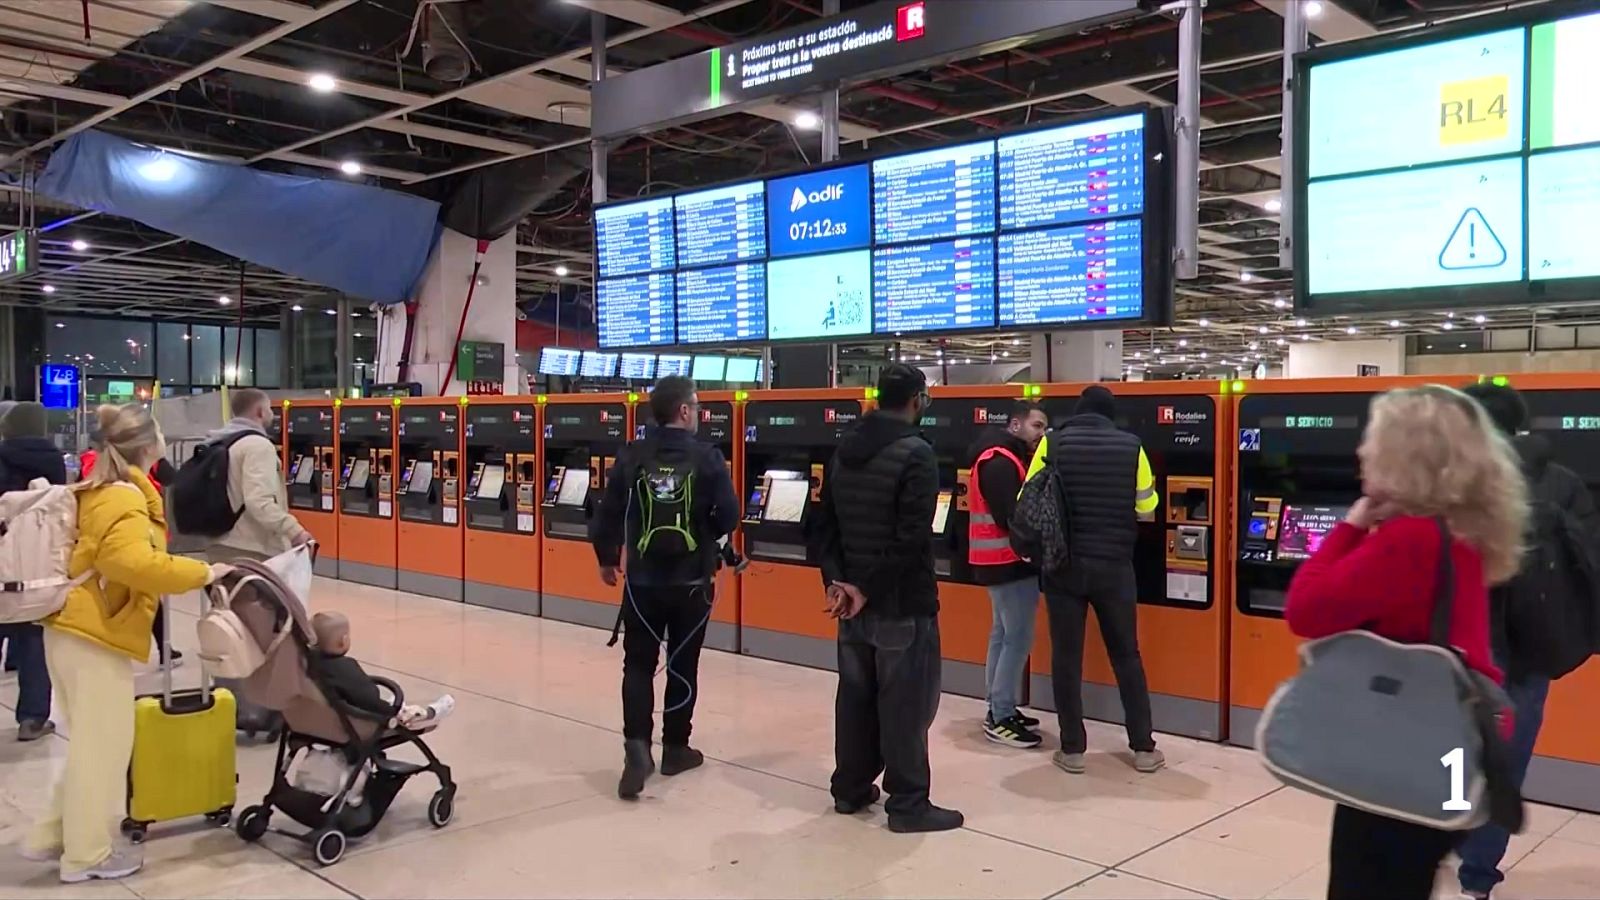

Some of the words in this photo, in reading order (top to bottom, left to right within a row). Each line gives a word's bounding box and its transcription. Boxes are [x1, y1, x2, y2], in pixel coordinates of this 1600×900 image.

[906, 6, 924, 31] R
[742, 43, 776, 62] Próximo
[778, 38, 796, 53] tren
[798, 36, 804, 47] a
[806, 32, 816, 46] su
[818, 20, 857, 42] estación
[742, 60, 770, 78] Proper
[772, 55, 790, 70] tren
[792, 53, 798, 64] a
[800, 49, 810, 62] la
[811, 41, 840, 59] vostra
[842, 24, 893, 52] destinació
[1440, 94, 1508, 127] RL4
[808, 184, 844, 204] adif
[980, 410, 987, 420] R
[1164, 408, 1174, 420] R
[1175, 412, 1206, 420] Rodalies
[1174, 434, 1200, 446] renfe
